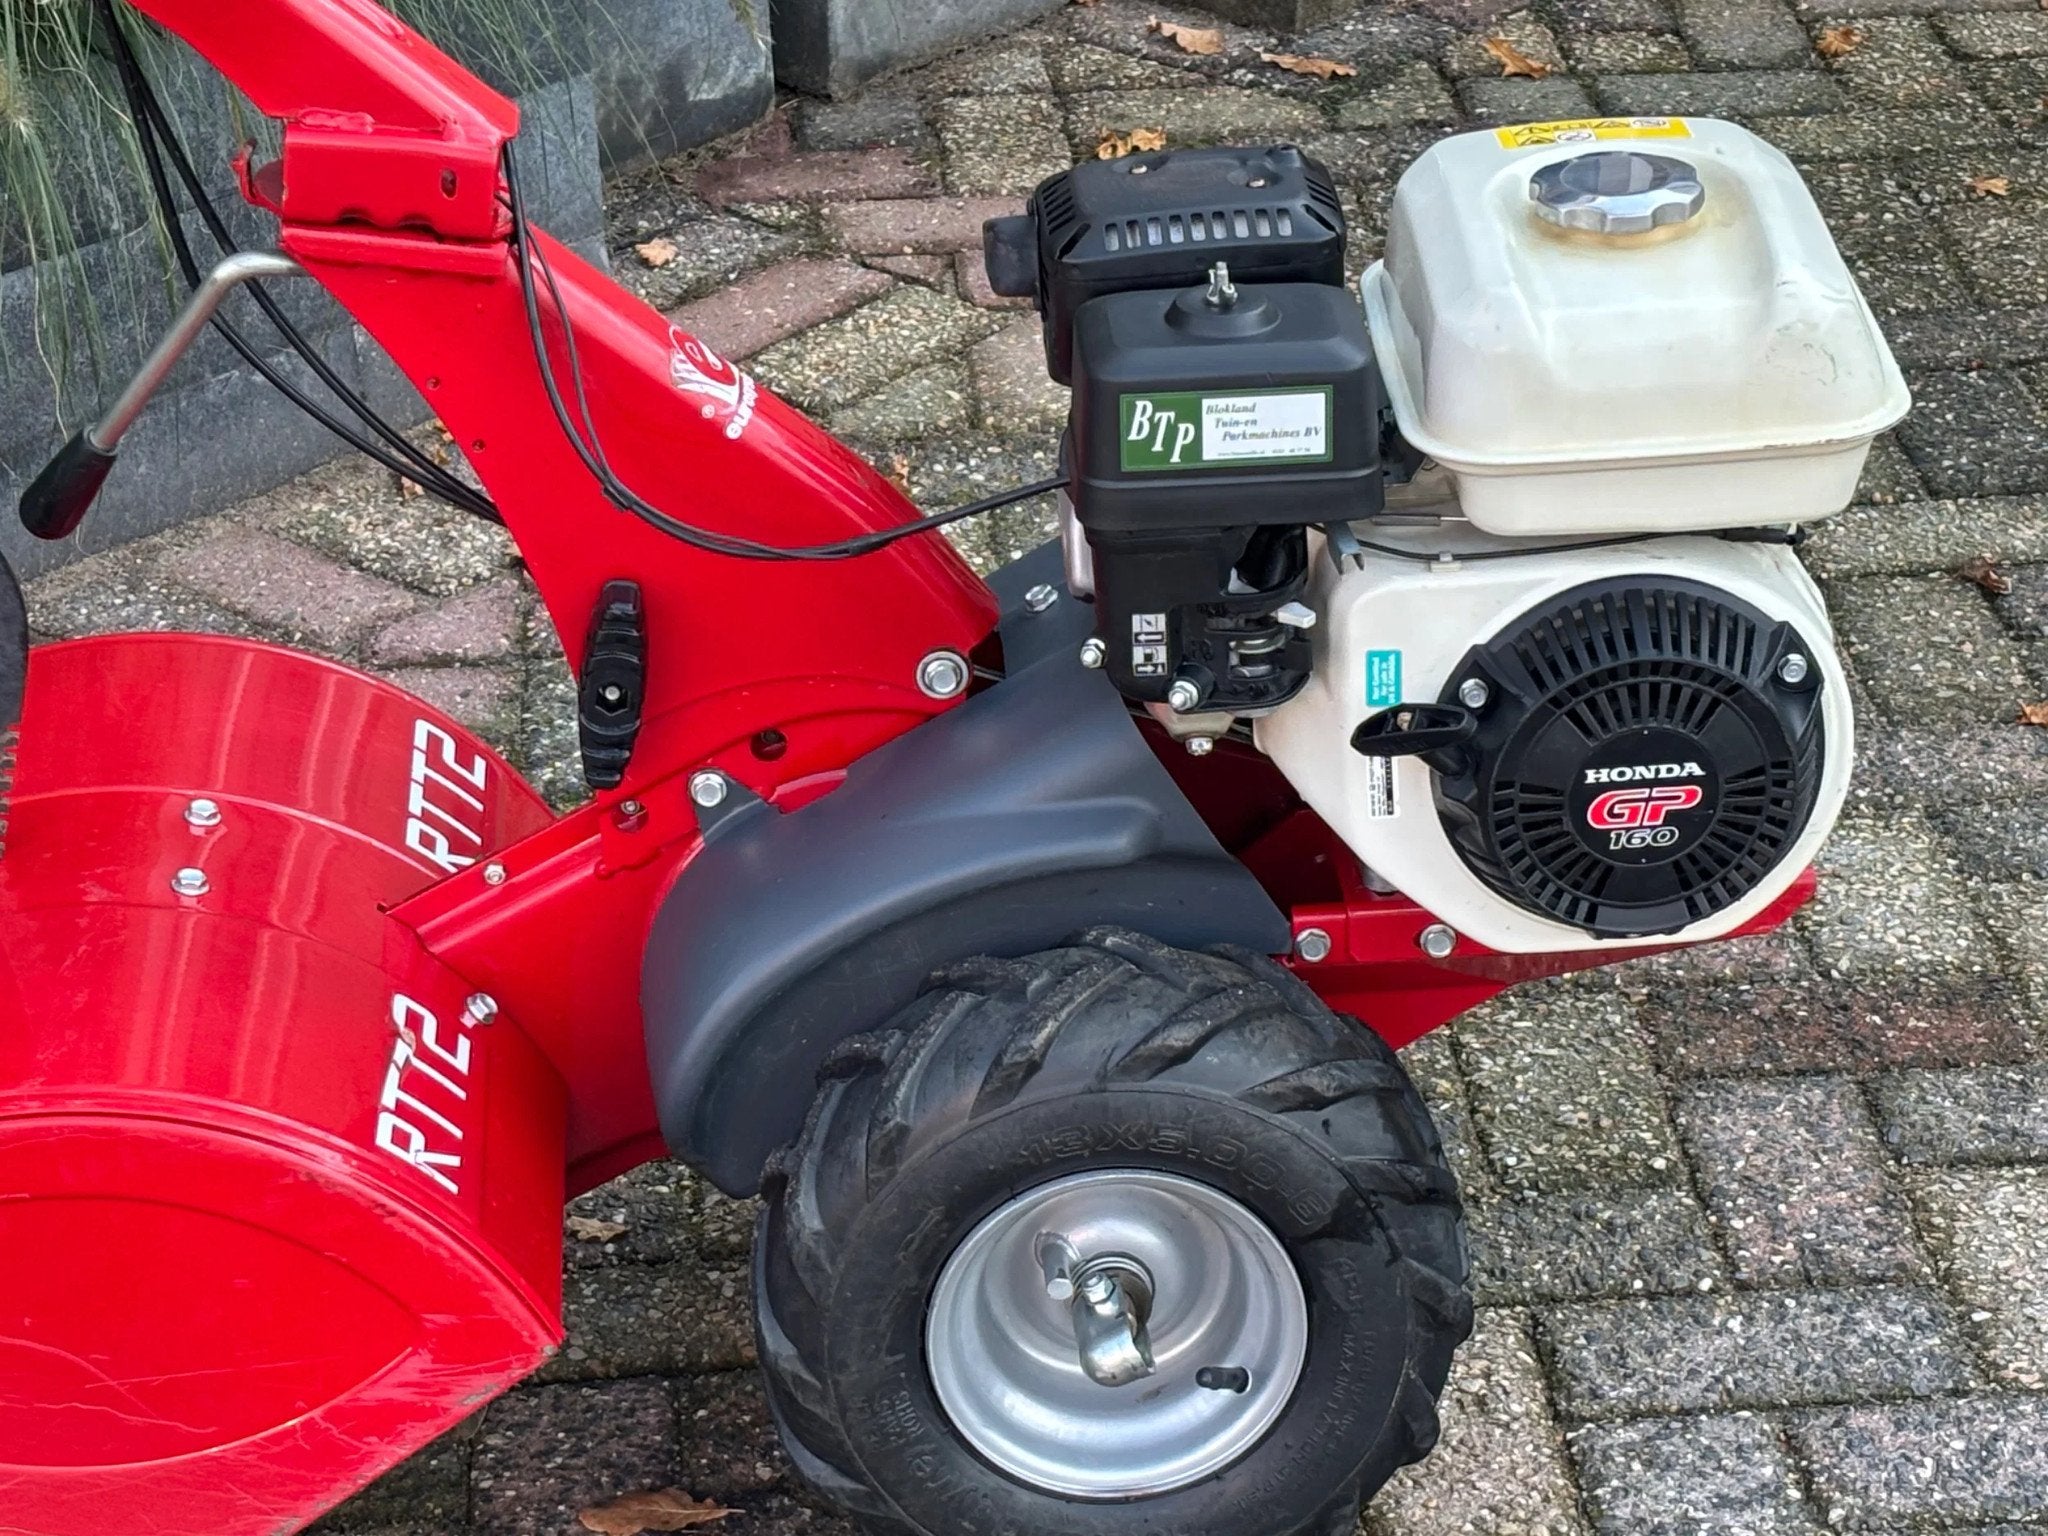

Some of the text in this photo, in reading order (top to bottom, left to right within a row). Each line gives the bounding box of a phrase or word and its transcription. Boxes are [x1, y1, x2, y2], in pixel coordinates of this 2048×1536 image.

[1206, 402, 1257, 415] Blokland
[1127, 400, 1196, 463] BTP
[1214, 418, 1258, 429] Tuin-en
[1222, 426, 1322, 442] Parkmachines BV
[1584, 762, 1706, 784] HONDA
[405, 718, 488, 874] RTT2
[1587, 785, 1702, 829] GP
[1609, 826, 1679, 850] 160
[375, 993, 472, 1196] RTT2
